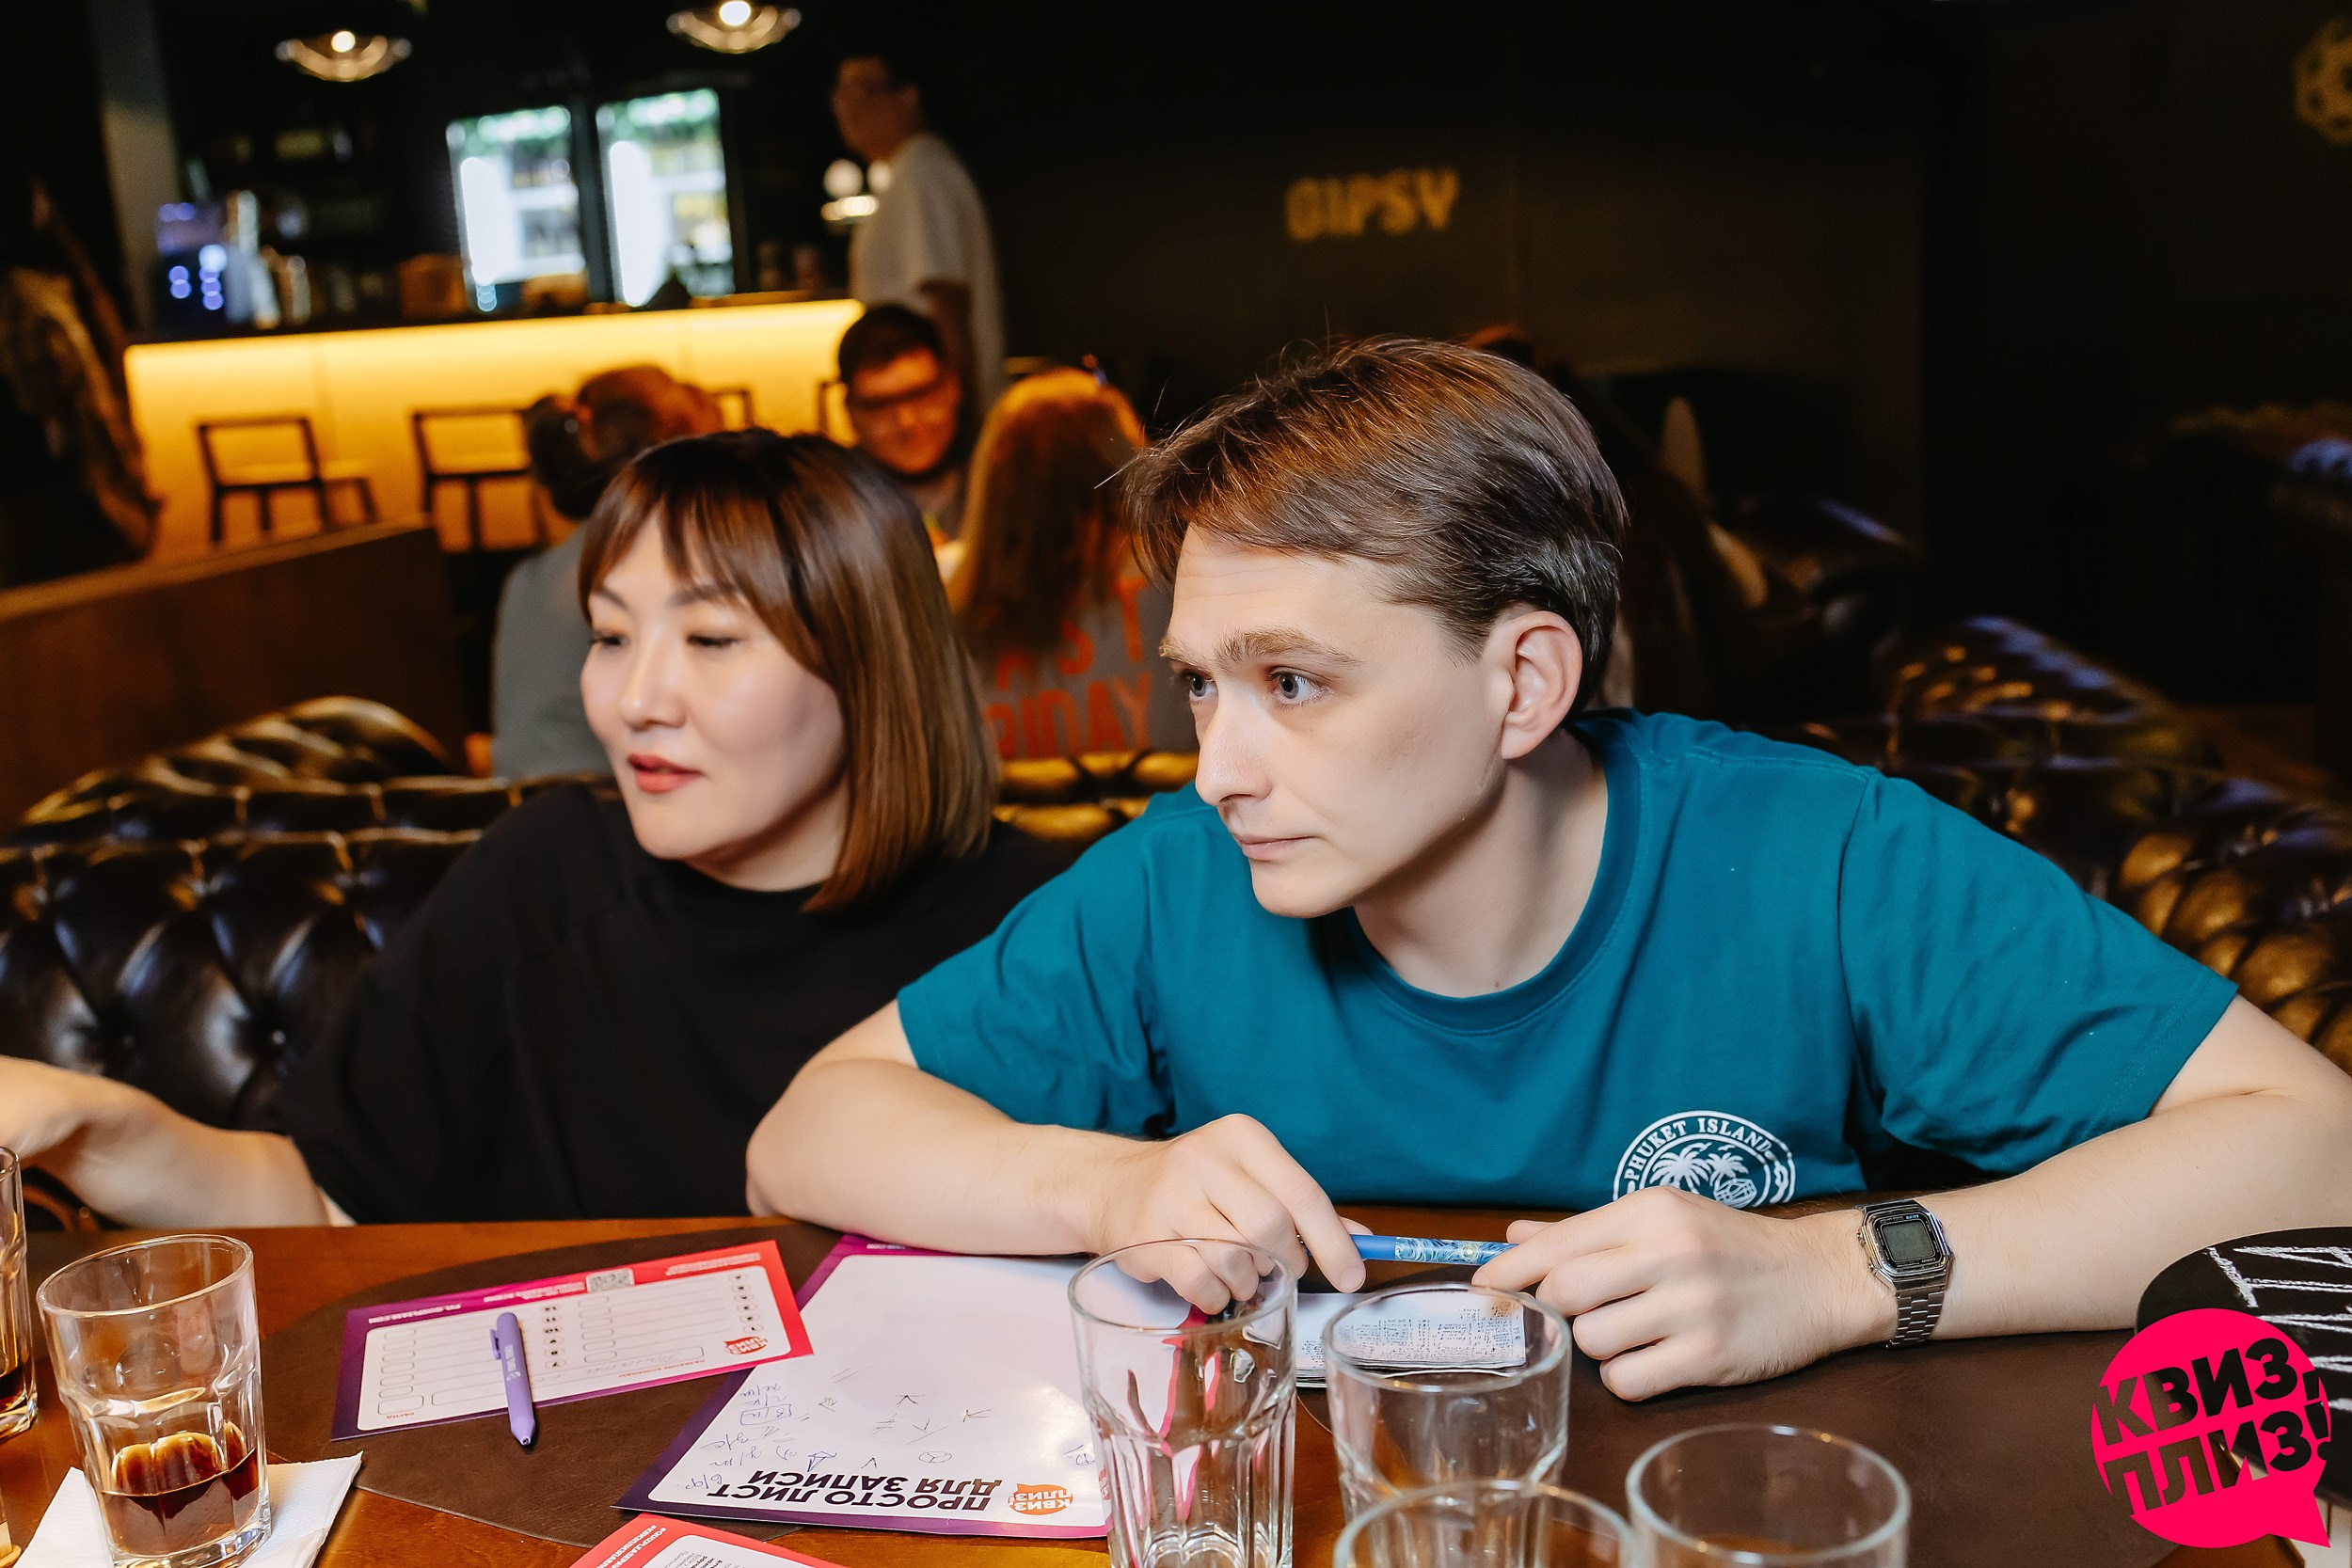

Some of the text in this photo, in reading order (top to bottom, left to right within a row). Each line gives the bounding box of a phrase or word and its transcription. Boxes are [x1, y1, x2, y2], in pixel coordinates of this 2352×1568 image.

[1285, 169, 1458, 241] GIPSY
[1624, 1117, 1772, 1181] PHUKET ISLAND
[707, 1483, 992, 1512] ПРОСТО ЛИСТ
[747, 1470, 1003, 1497] ДЛЯ ЗАПИСИ
